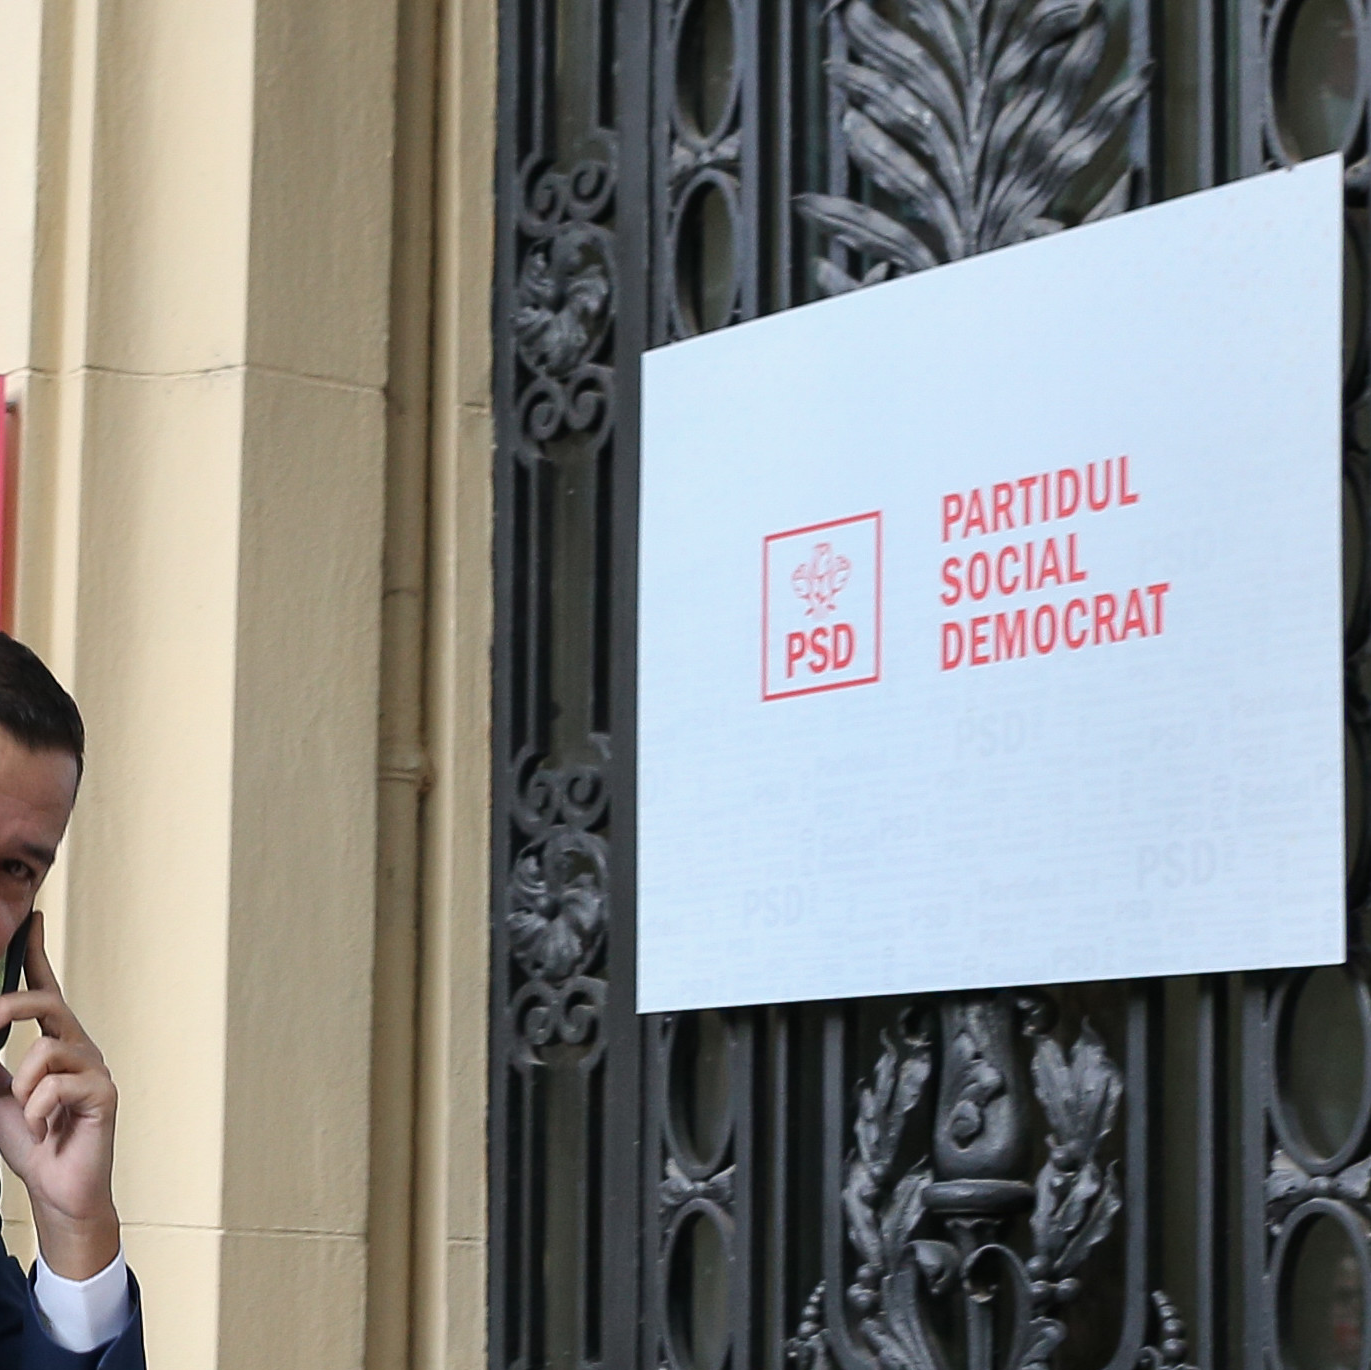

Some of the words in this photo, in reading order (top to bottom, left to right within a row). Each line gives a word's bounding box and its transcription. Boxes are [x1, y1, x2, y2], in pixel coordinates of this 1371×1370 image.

[942, 456, 1140, 542] PARTIDUL
[941, 534, 1088, 606] SOCIAL
[786, 622, 856, 679] PSD
[941, 582, 1172, 671] DEMOCRAT
